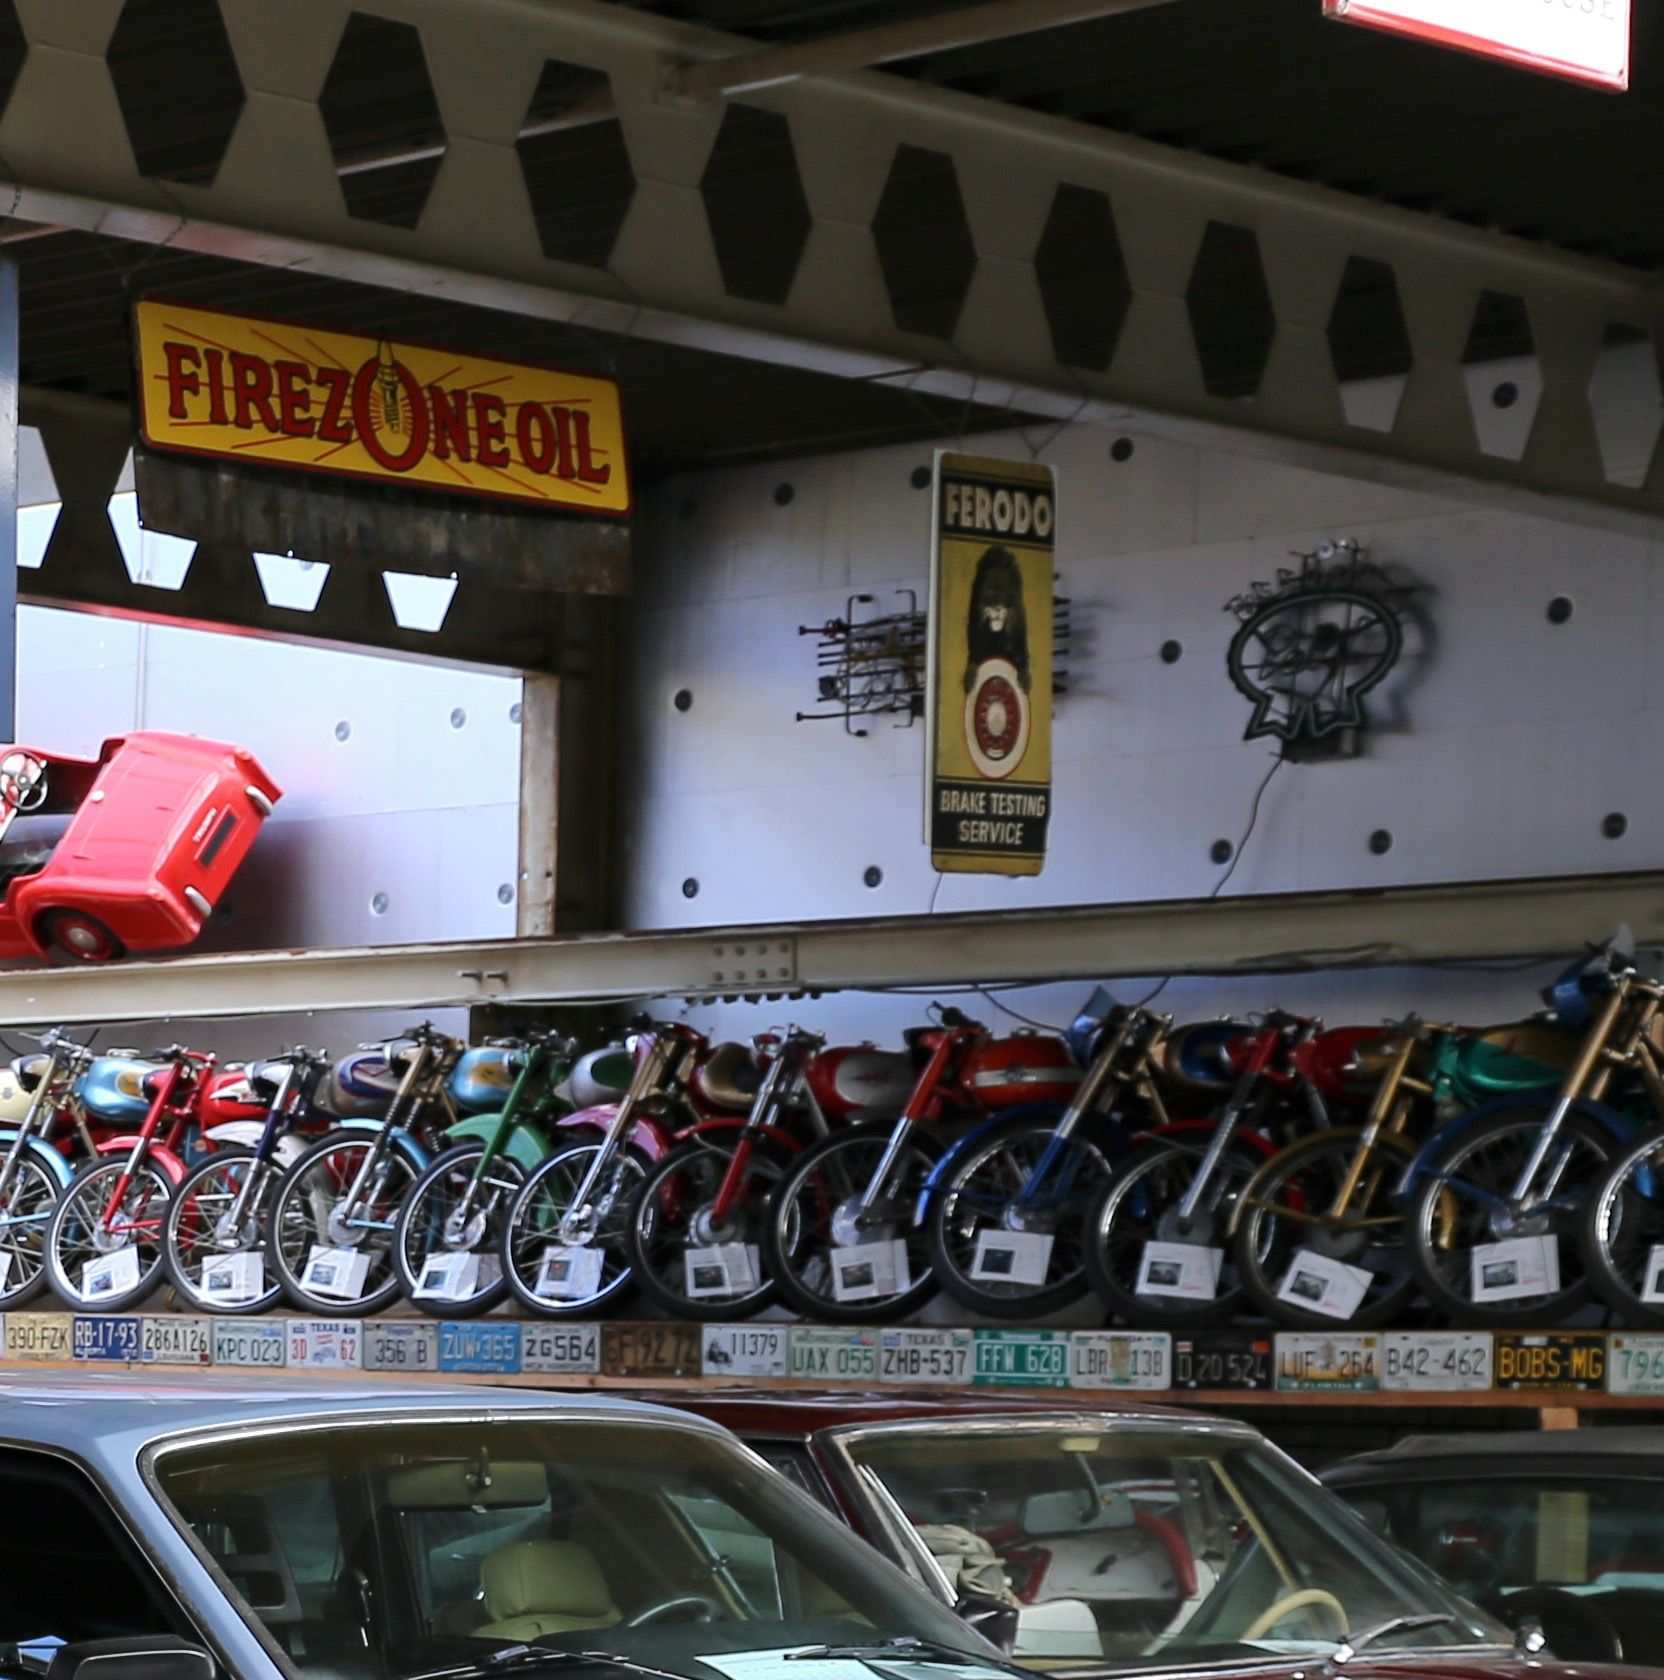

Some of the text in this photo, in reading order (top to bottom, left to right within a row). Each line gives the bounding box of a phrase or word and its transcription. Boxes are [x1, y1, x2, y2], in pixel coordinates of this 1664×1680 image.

[164, 341, 610, 485] FIREZONE OIL
[946, 482, 1052, 537] FERODO
[940, 788, 1046, 817] BRAKE TESTING
[959, 820, 1023, 846] SERVICE
[8, 1327, 69, 1350] 390-FZK
[75, 1321, 137, 1348] RB-17-93
[145, 1327, 207, 1353] 286A126
[311, 1321, 341, 1333] TEXAS
[906, 1333, 945, 1345] TEXAS
[217, 1338, 282, 1362] KPC 023
[340, 1339, 356, 1361] 62
[375, 1339, 427, 1363] 356 B
[731, 1333, 777, 1356] 11379
[792, 1348, 874, 1374] UAX 055
[884, 1348, 966, 1375] ZHB-537
[981, 1344, 1062, 1372] FFW 628
[1076, 1348, 1108, 1377] LBR
[1341, 1350, 1373, 1379] 264
[1388, 1347, 1486, 1377] B42-462
[1499, 1346, 1603, 1379] BOBS-MG
